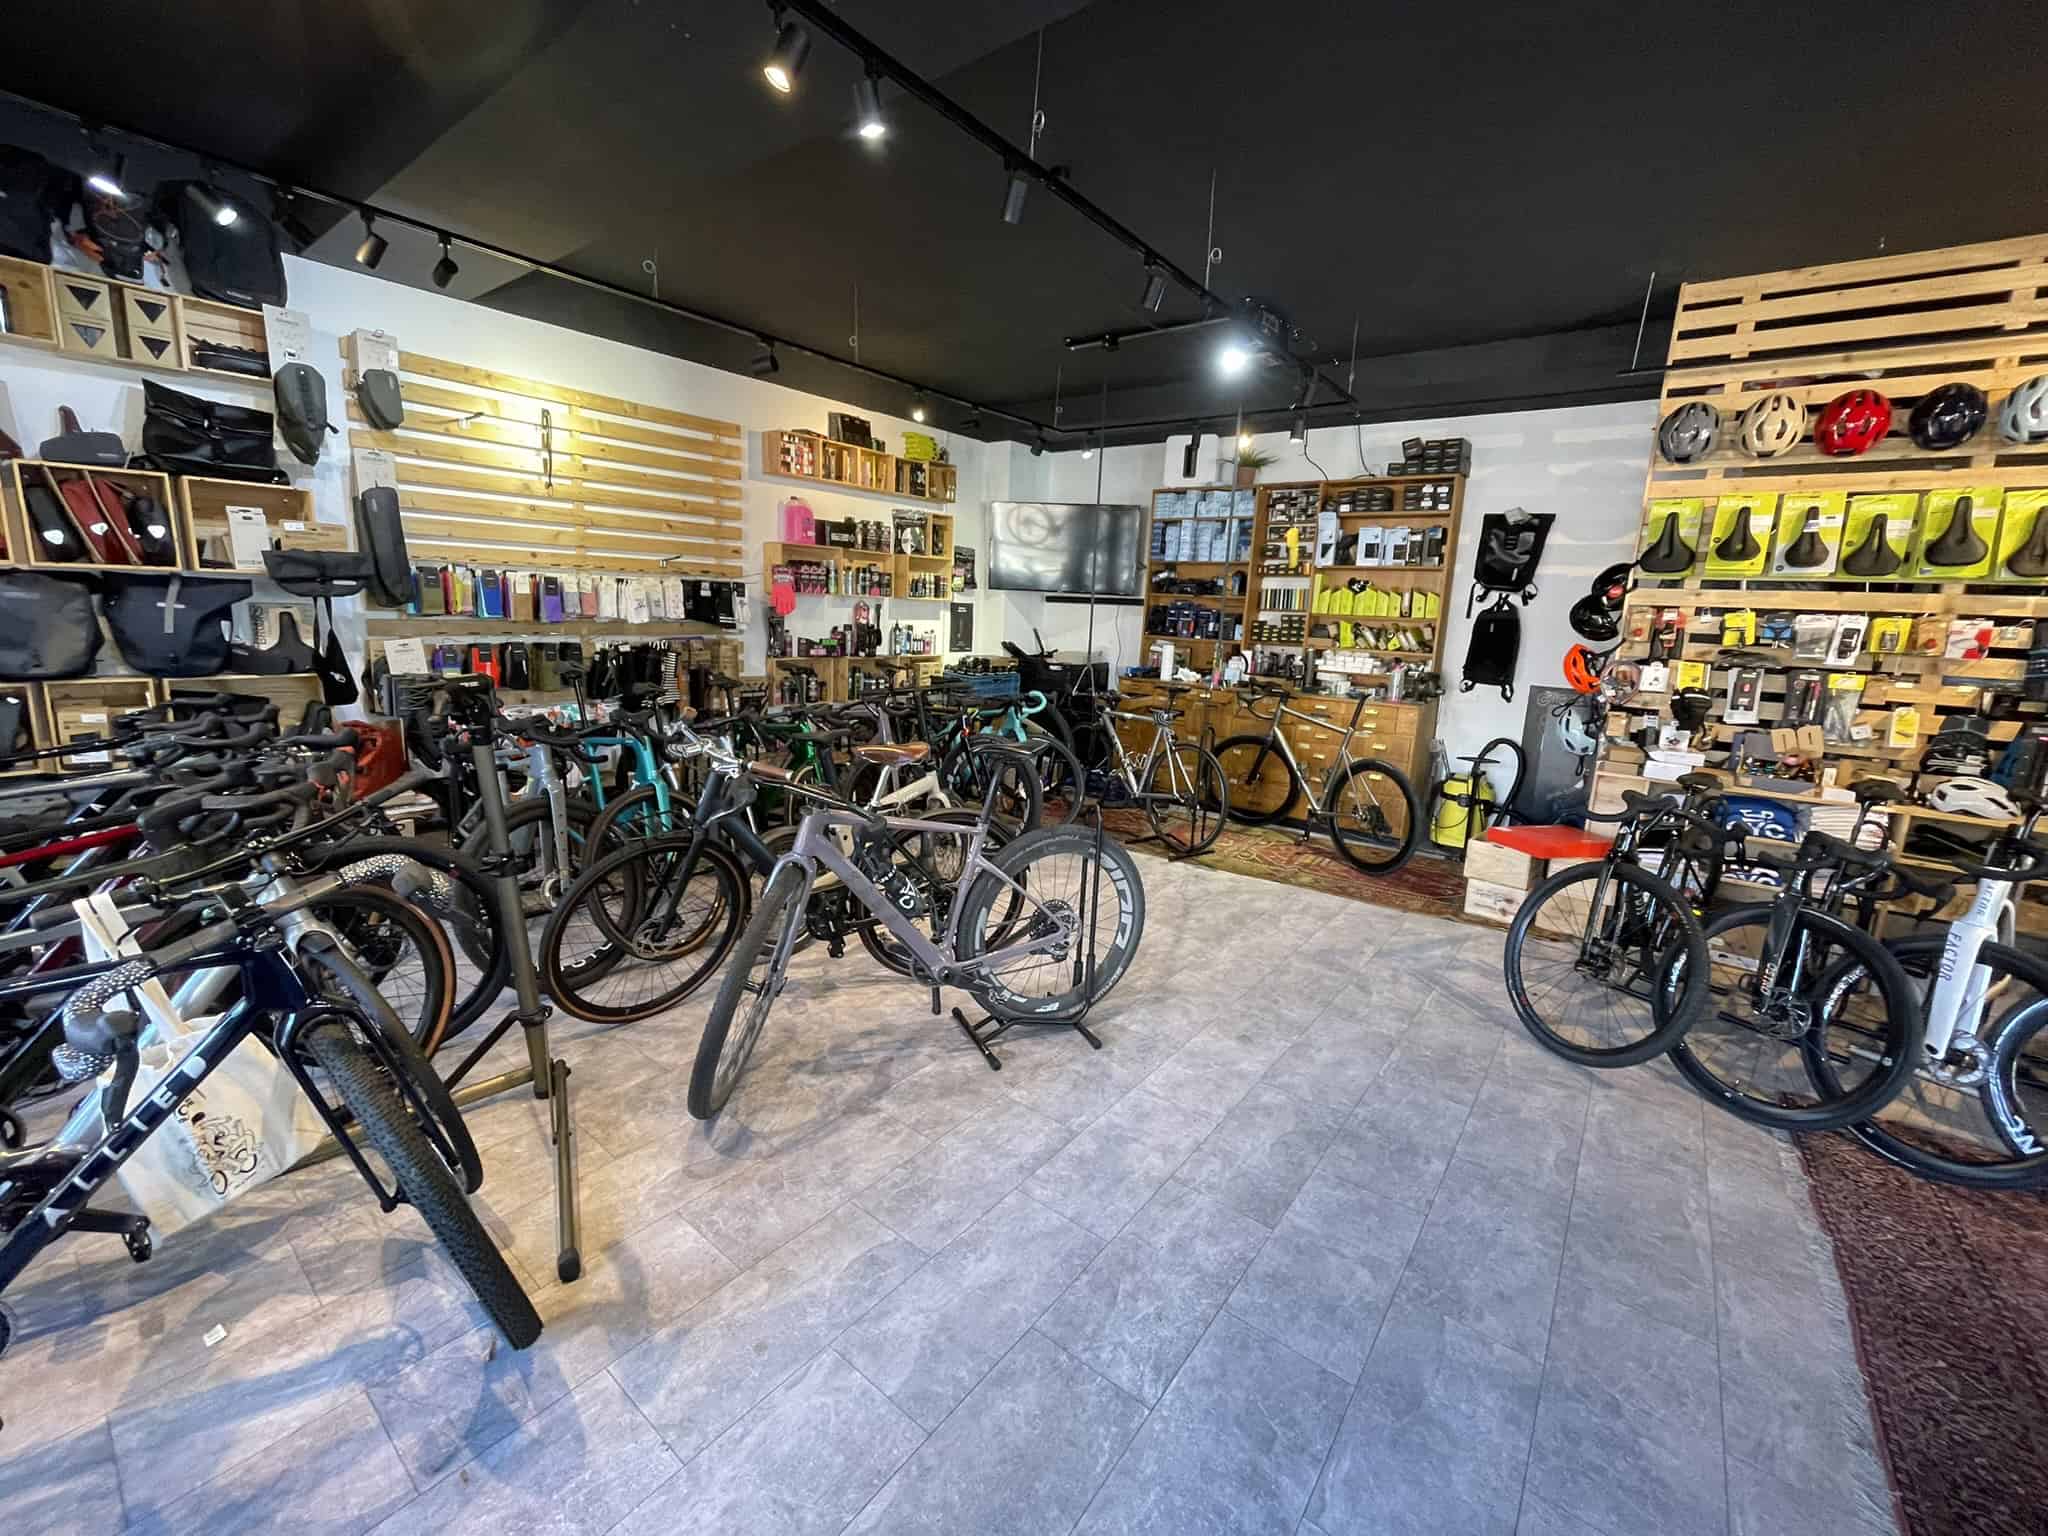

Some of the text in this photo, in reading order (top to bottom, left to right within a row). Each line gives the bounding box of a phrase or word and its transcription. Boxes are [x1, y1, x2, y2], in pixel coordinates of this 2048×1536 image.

[1976, 884, 1996, 916] ACTOR
[1938, 931, 1962, 982] FACTOR
[42, 1055, 208, 1229] ALLIED
